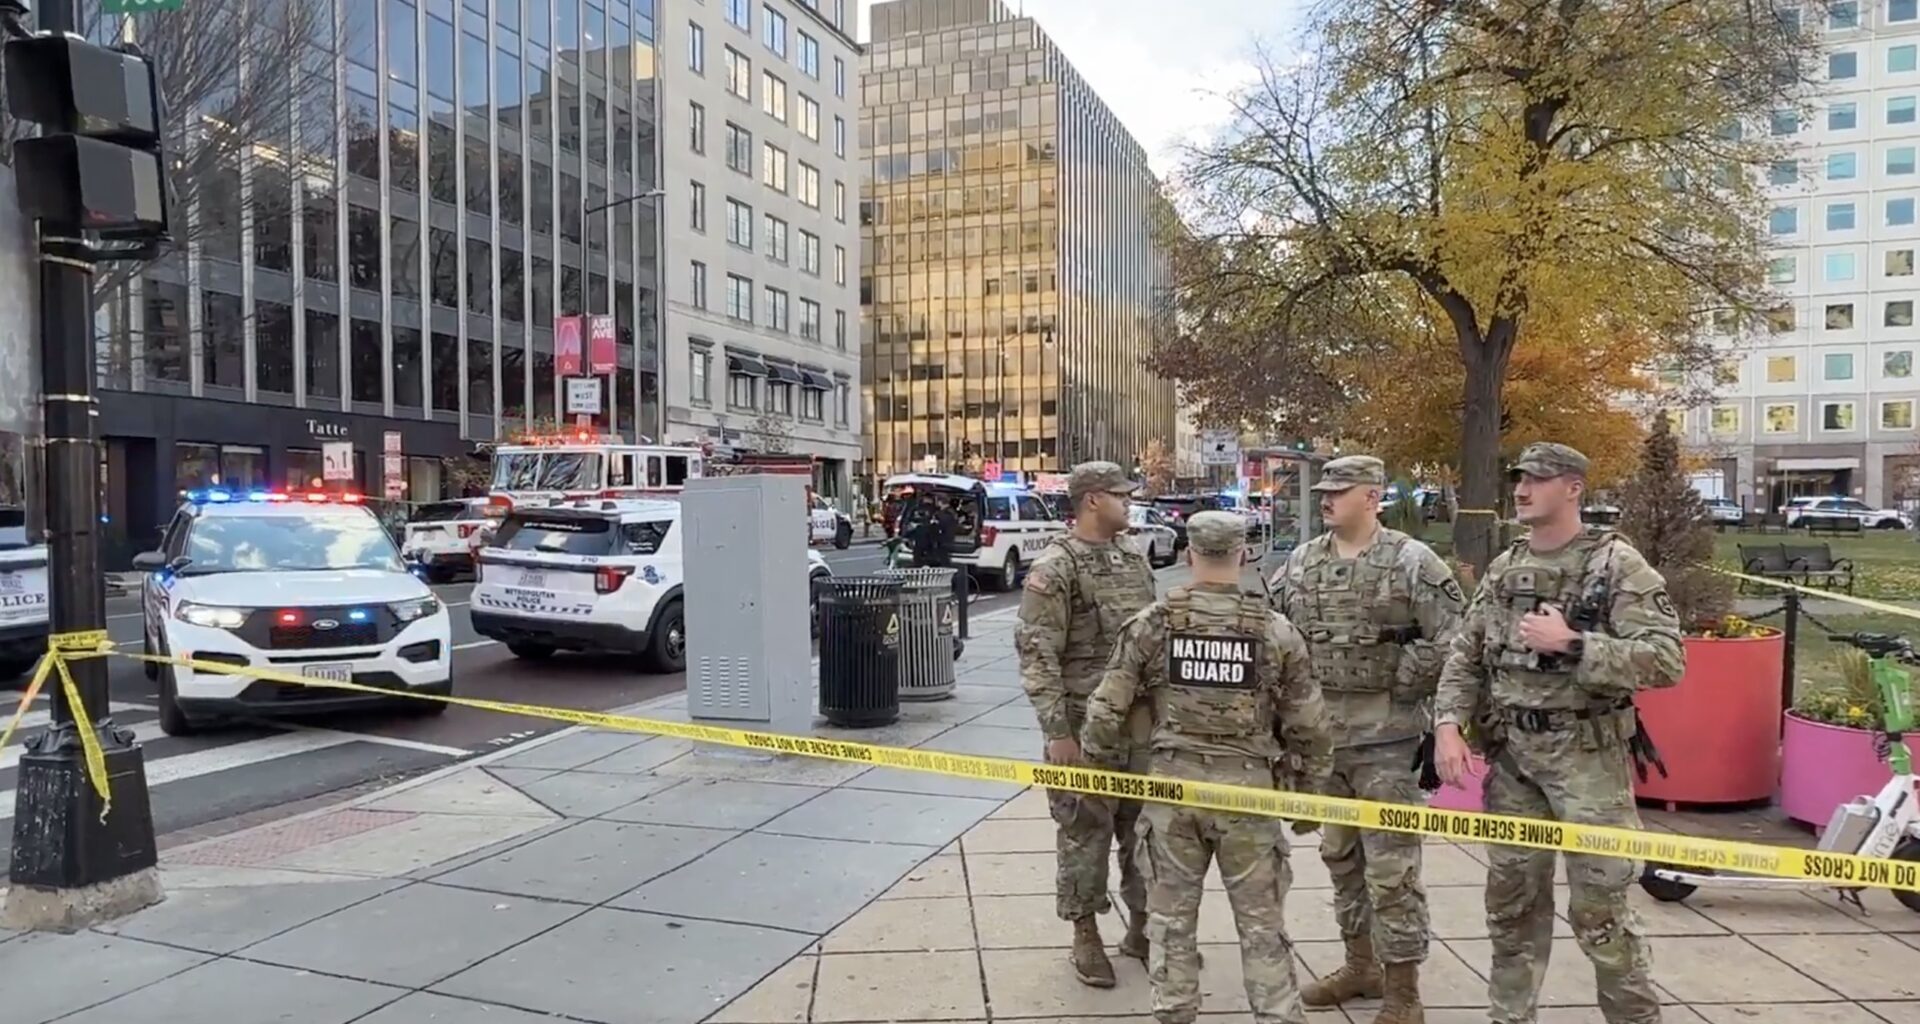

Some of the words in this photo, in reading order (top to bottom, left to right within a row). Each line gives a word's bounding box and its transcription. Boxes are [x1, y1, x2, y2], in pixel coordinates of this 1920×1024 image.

[592, 319, 613, 329] ART
[592, 329, 613, 339] AVE
[306, 419, 348, 436] Tatte
[0, 593, 46, 607] LICE
[505, 588, 555, 599] METROPOLITAN
[517, 596, 541, 604] POLICE
[1173, 638, 1253, 662] NATIONAL
[1181, 660, 1244, 683] GUARD
[744, 733, 775, 748] CROSS
[776, 738, 794, 750] NOT
[795, 739, 809, 752] DO
[809, 741, 840, 756] SCENE
[840, 744, 872, 760] CRIME
[1033, 768, 1066, 786] CROSS
[1070, 772, 1089, 789] NOT
[1093, 774, 1107, 791] DO
[1111, 776, 1145, 796] SCENE
[1149, 781, 1183, 801] CRIME
[1194, 788, 1230, 804] CROSS
[1235, 794, 1256, 809] NOT
[1260, 797, 1276, 812] DO
[1280, 799, 1318, 816] SCENE
[1320, 804, 1360, 822] CRIME
[1379, 808, 1420, 830] CROSS
[1424, 813, 1448, 832] NOT
[1452, 816, 1469, 835] DO
[1474, 818, 1514, 840] SCENE
[1519, 823, 1563, 845] CRIME
[1575, 833, 1620, 850] CROSS
[1626, 838, 1653, 855] NOT
[1657, 842, 1676, 859] DO
[1681, 847, 1726, 865] SCENE
[1734, 853, 1780, 871] CRIME
[1804, 855, 1854, 880] CROSS
[1859, 861, 1889, 883] NOT
[1895, 864, 1916, 887] DO
